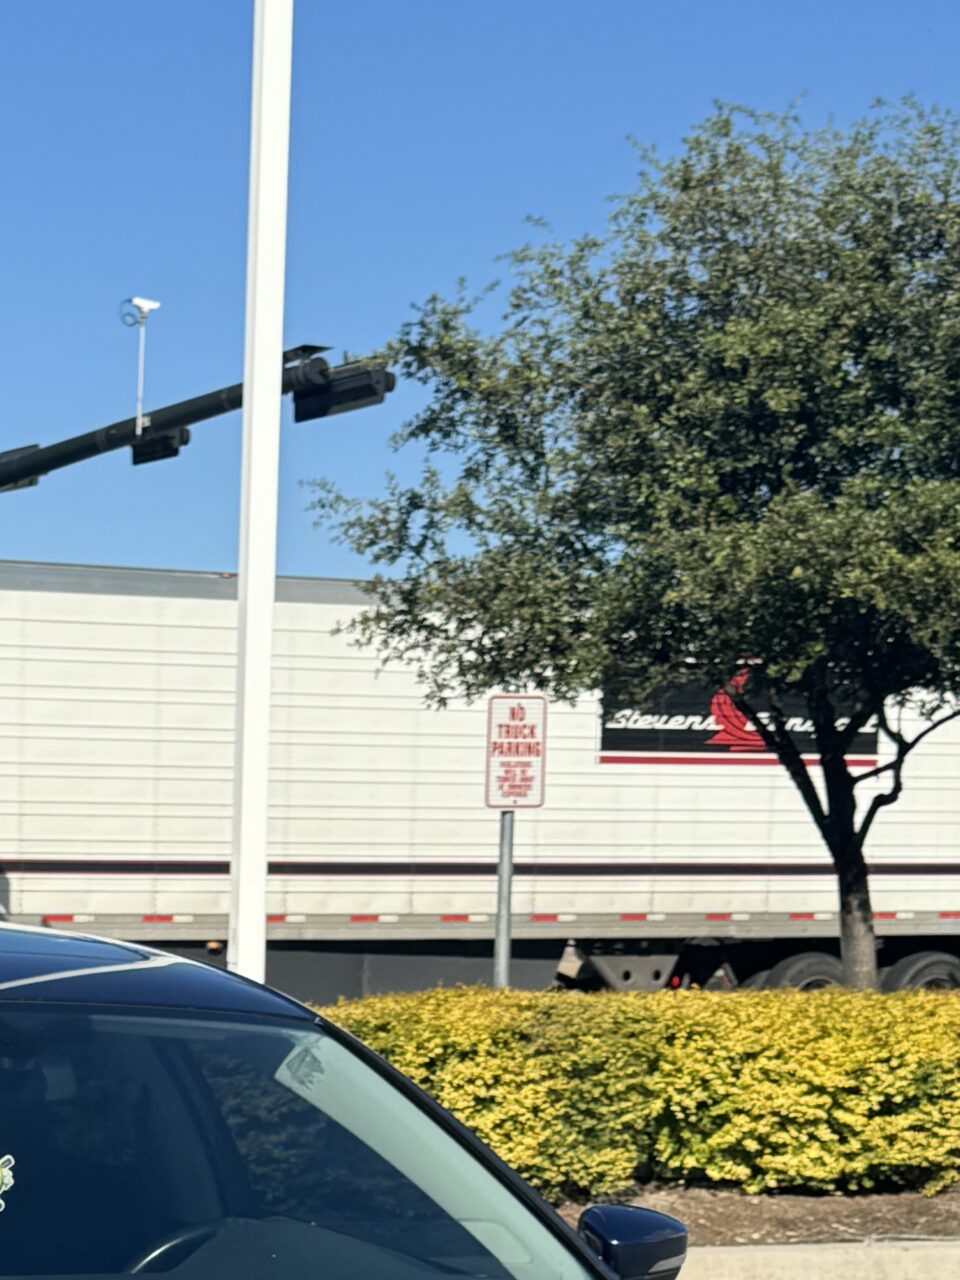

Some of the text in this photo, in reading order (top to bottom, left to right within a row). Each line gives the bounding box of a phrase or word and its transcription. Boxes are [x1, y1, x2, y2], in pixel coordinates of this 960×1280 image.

[509, 706, 526, 721] NO
[604, 708, 725, 731] Stevens
[497, 724, 537, 739] TRUCK
[492, 741, 541, 757] PARKING
